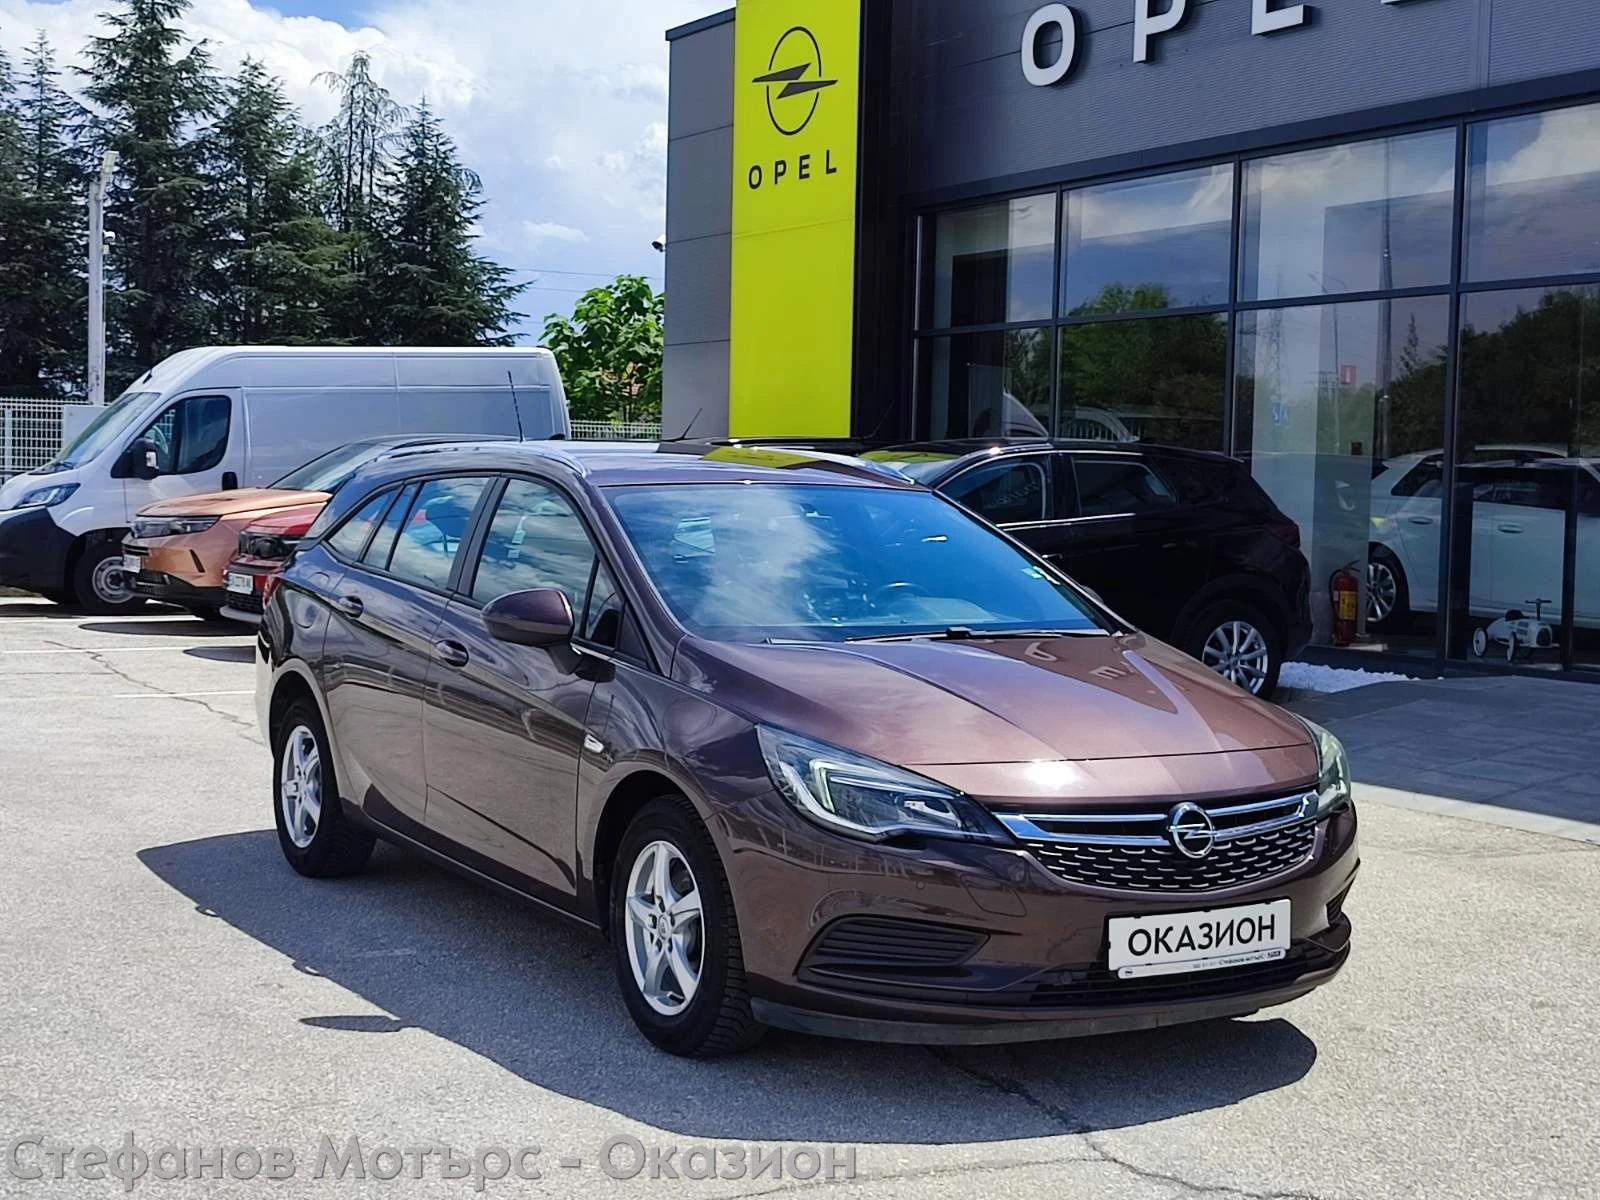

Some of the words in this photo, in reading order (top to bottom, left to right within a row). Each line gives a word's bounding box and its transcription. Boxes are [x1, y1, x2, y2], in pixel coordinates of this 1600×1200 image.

[1021, 0, 1400, 87] OP
[748, 149, 838, 190] OPEL
[1127, 913, 1276, 957] ОКАЗИОН
